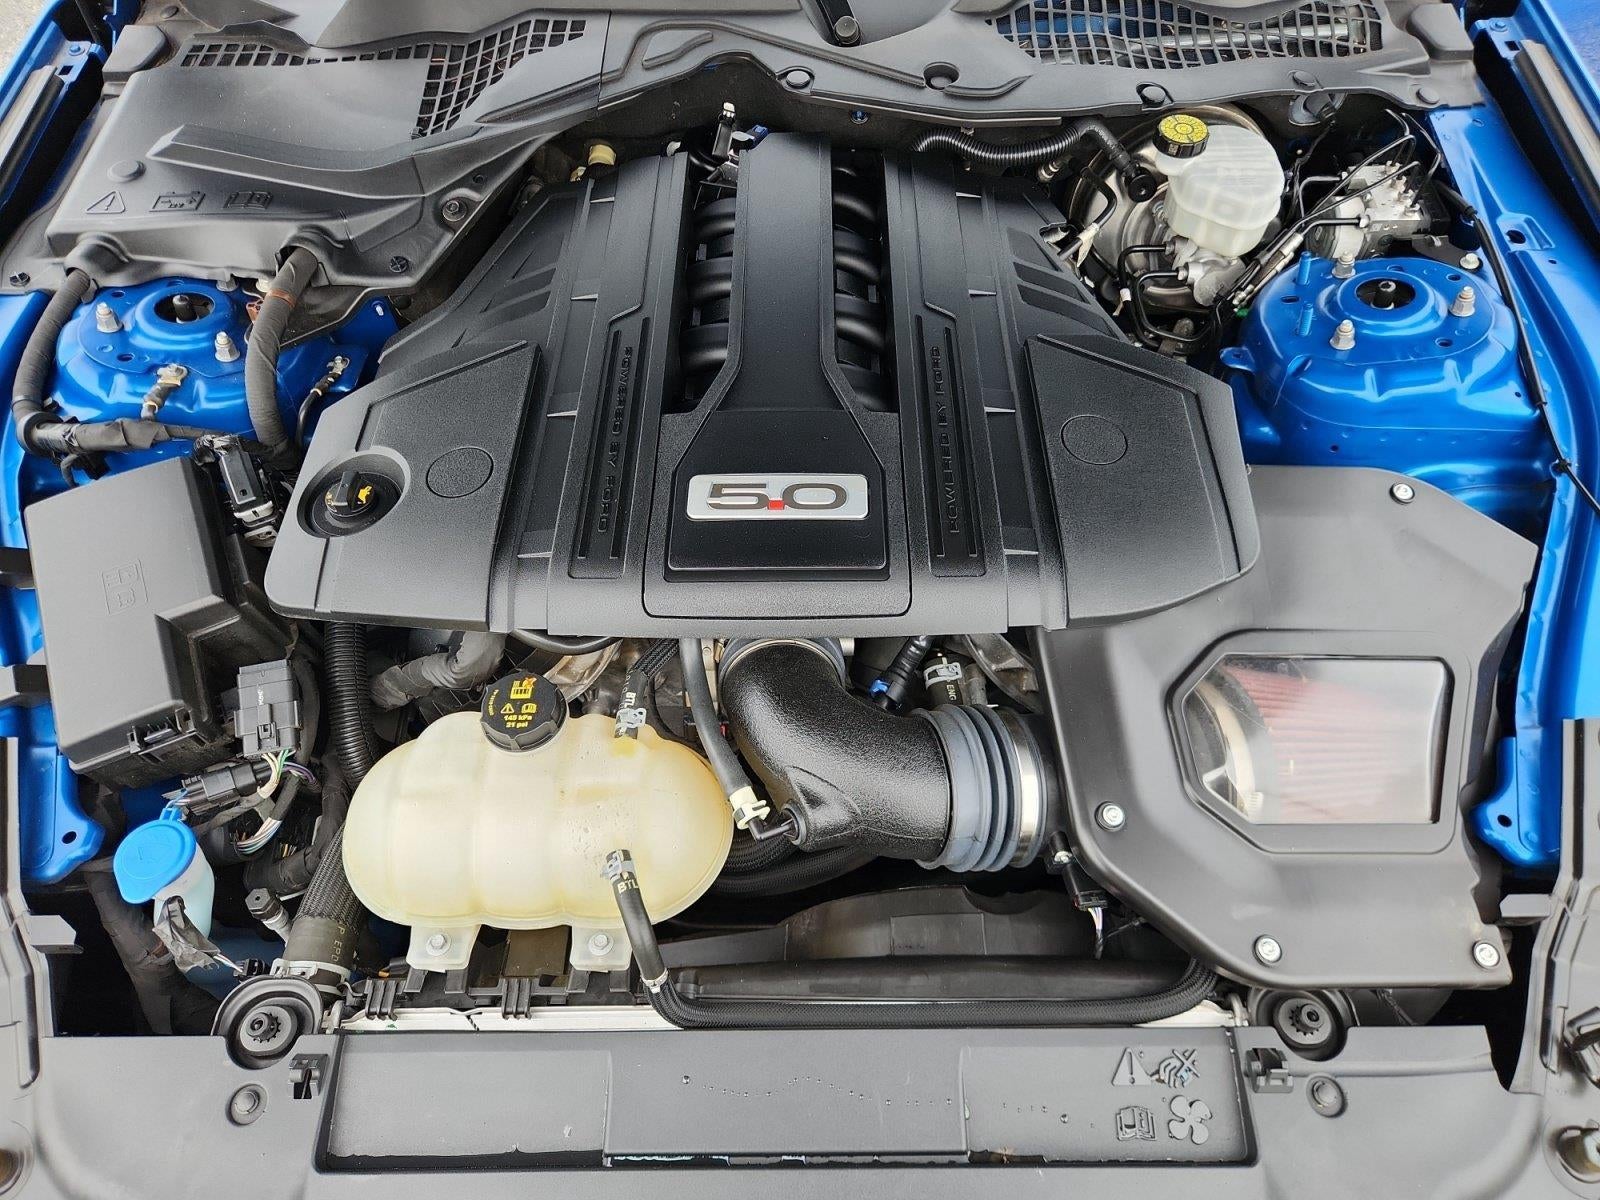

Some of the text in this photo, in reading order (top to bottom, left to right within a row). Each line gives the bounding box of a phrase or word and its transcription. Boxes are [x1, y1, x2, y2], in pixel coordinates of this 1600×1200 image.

[598, 346, 632, 533] POWERED BY FORD
[931, 346, 960, 533] POWERED BY FORD
[706, 482, 848, 511] 5.0
[624, 691, 637, 708] BTL
[946, 684, 957, 701] ENG
[617, 879, 639, 895] BTL
